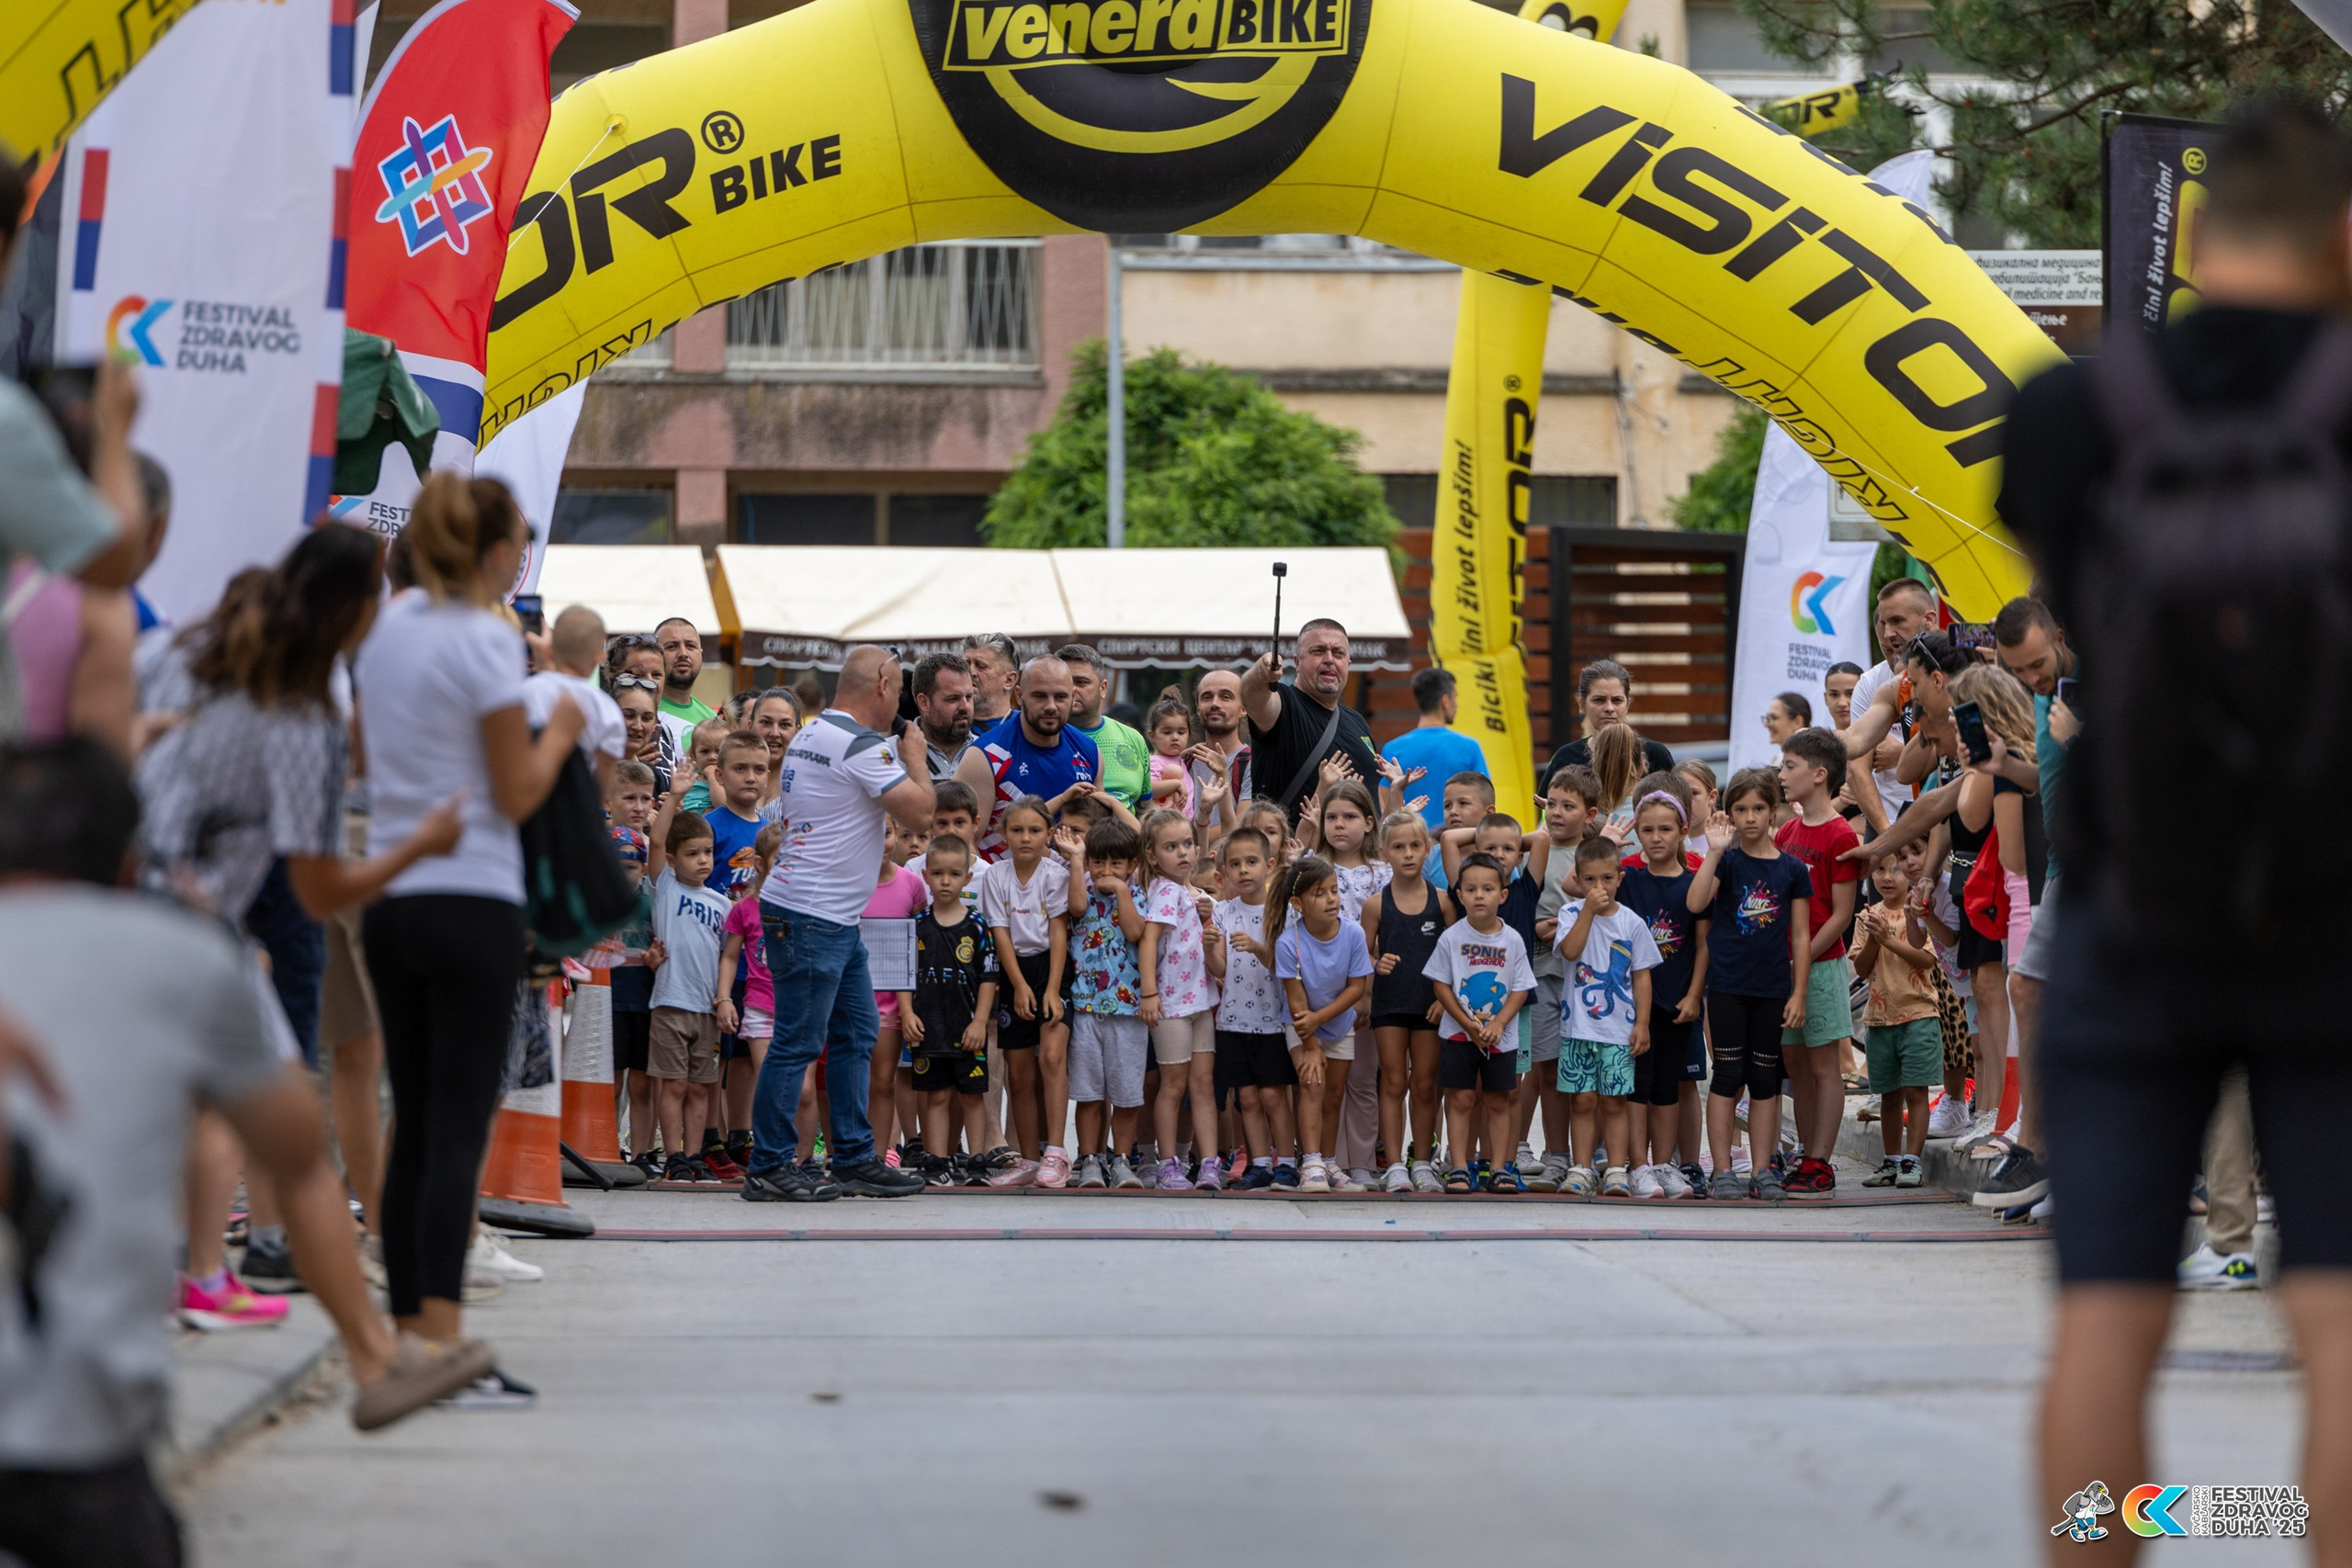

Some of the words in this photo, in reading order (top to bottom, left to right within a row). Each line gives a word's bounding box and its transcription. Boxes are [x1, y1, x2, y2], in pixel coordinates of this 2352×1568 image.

[962, 0, 1216, 60] venera
[1227, 0, 1338, 44] BIKE
[709, 134, 842, 215] BIKE
[2013, 288, 2063, 300] medicine
[2066, 288, 2087, 300] and
[184, 300, 296, 329] FESTIVAL
[180, 325, 301, 354] ZDRAVOG
[176, 349, 246, 374] DUHA
[1452, 438, 1480, 540] lepšim!
[368, 501, 412, 523] FEST
[1454, 546, 1479, 613] život
[1788, 643, 1832, 660] FESTIVAL
[1787, 668, 1818, 682] DUHA
[1745, 897, 1770, 909] NIKE
[1461, 943, 1507, 959] SONIC
